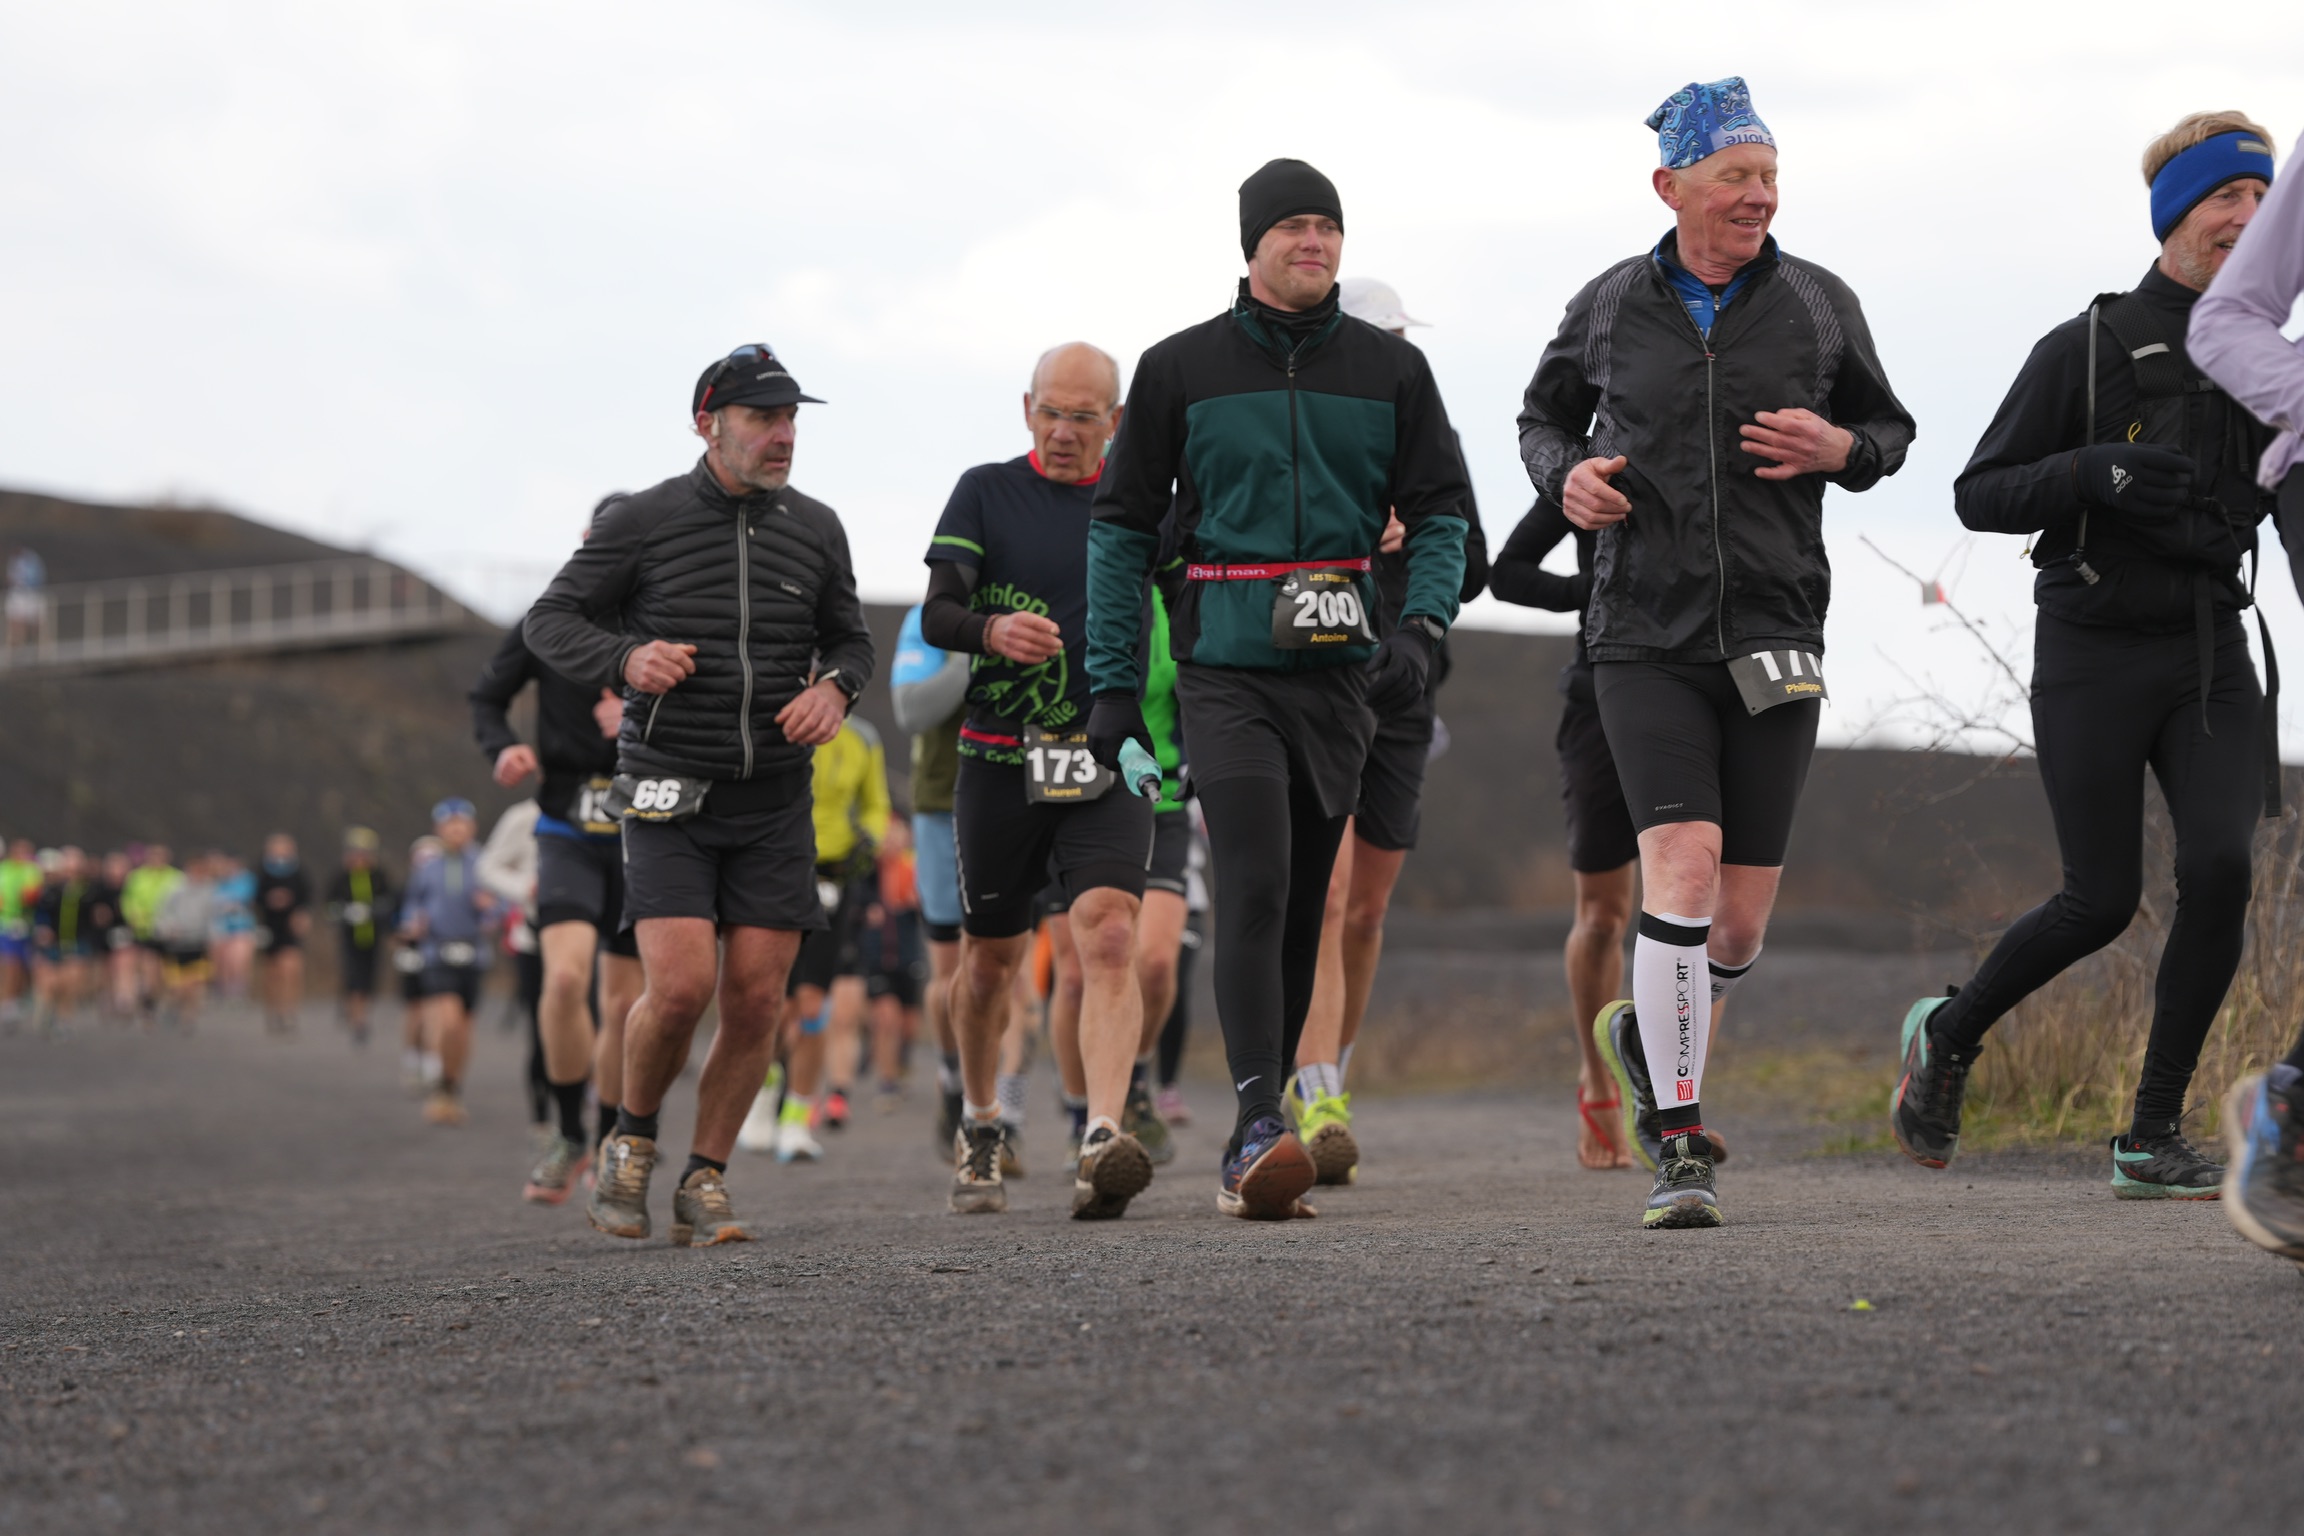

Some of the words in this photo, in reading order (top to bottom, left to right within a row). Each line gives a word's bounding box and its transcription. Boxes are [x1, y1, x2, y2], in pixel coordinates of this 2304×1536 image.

[1293, 590, 1360, 629] 200
[1311, 633, 1348, 643] Antoine
[1027, 747, 1098, 784] 173
[632, 779, 682, 811] 66
[1043, 787, 1082, 798] Laurent
